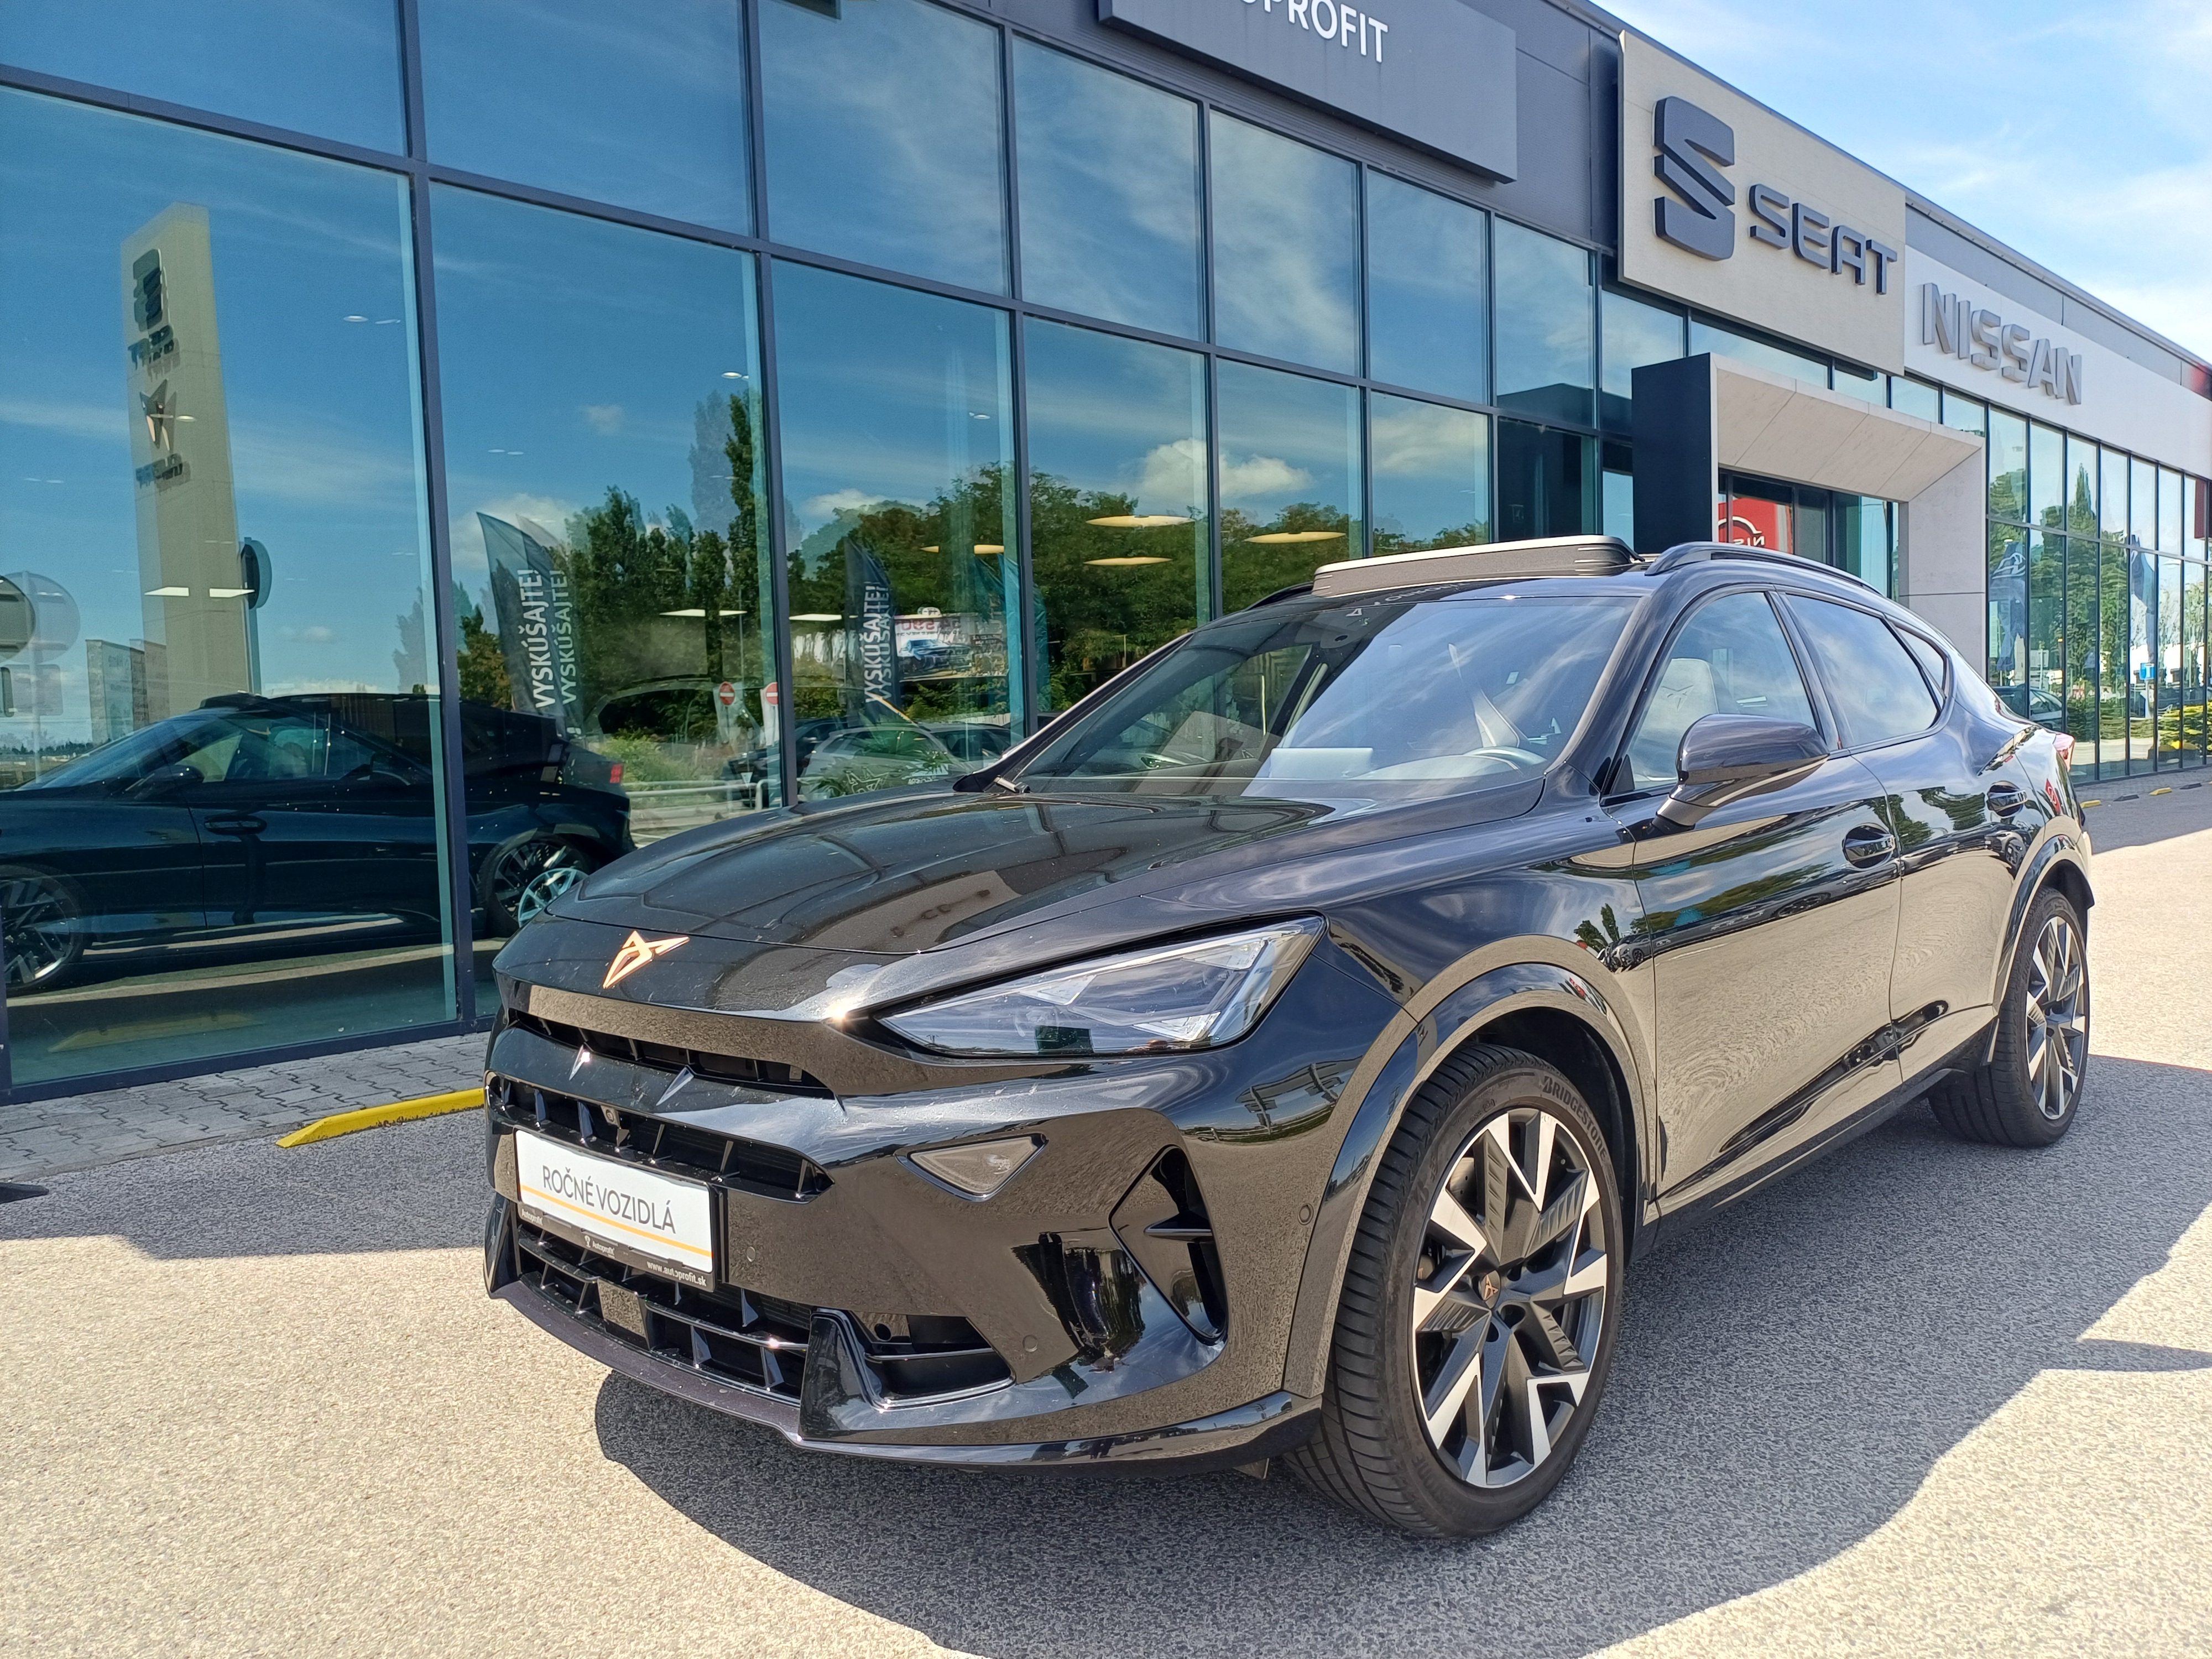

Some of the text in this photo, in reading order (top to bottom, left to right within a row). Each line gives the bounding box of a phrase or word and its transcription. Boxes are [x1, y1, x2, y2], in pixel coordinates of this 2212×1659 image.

[1240, 0, 1389, 63] ROFIT
[1748, 183, 1897, 295] SEAT
[1922, 282, 2082, 405] NISSAN
[517, 569, 556, 708] VYSKÚŠAJTE!
[549, 570, 577, 705] VYSKÚŠAJTE!
[1542, 1075, 1607, 1161] BRIDGESTONE
[542, 1165, 676, 1234] ROČNÉ VOZIDLÁ
[646, 1261, 707, 1287] www.autoprofit.sk
